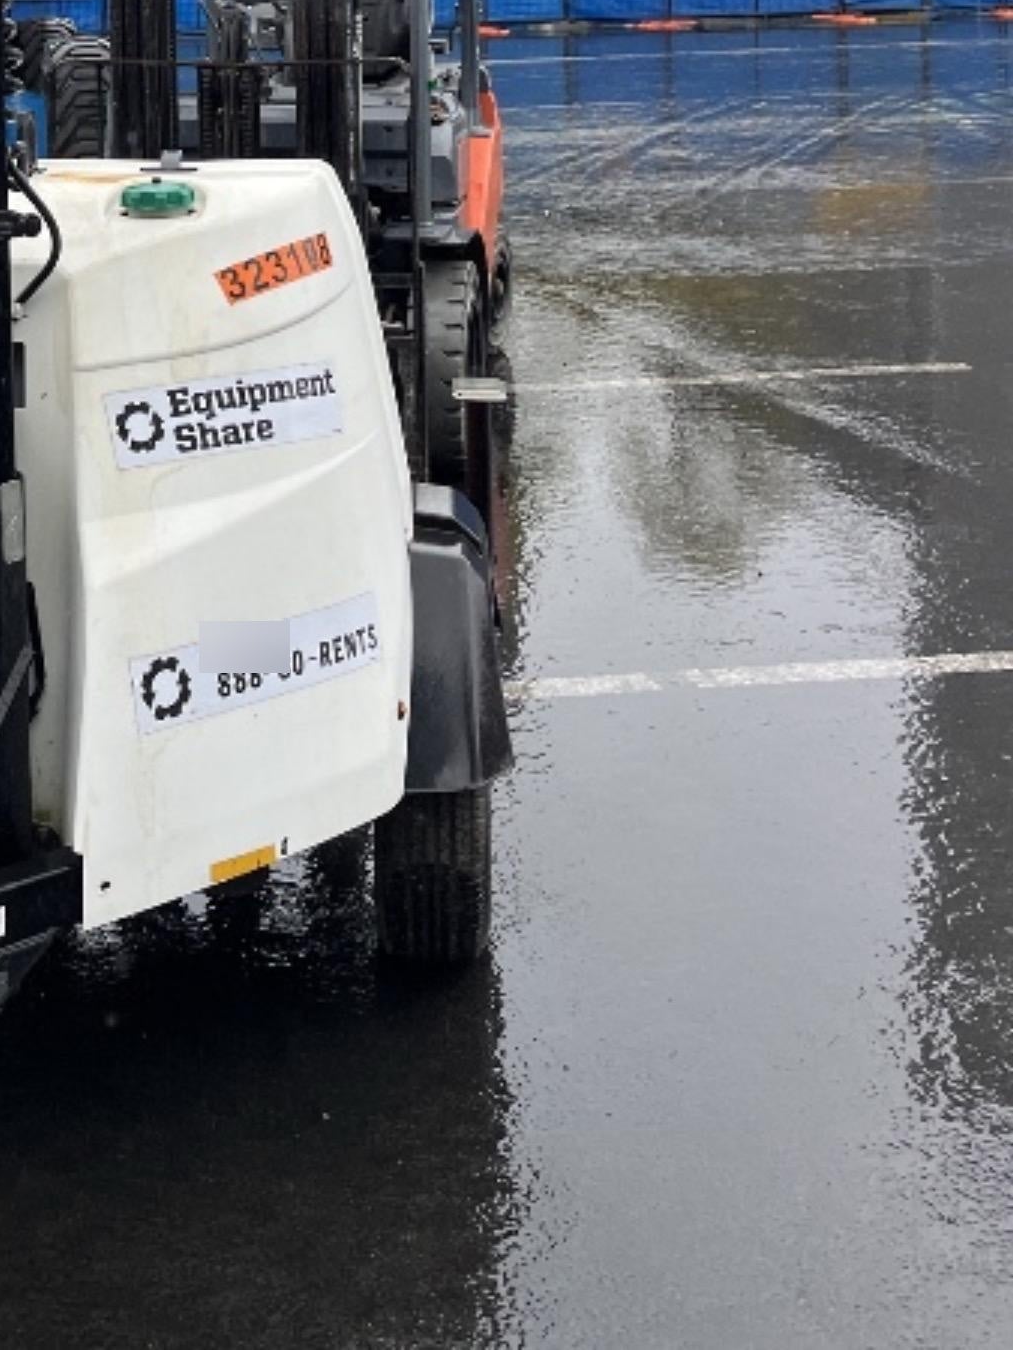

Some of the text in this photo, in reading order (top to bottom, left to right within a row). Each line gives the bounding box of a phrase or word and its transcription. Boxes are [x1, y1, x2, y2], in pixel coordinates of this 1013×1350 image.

[219, 232, 331, 299] 323108
[165, 368, 337, 420] Equipment
[173, 418, 275, 453] Share
